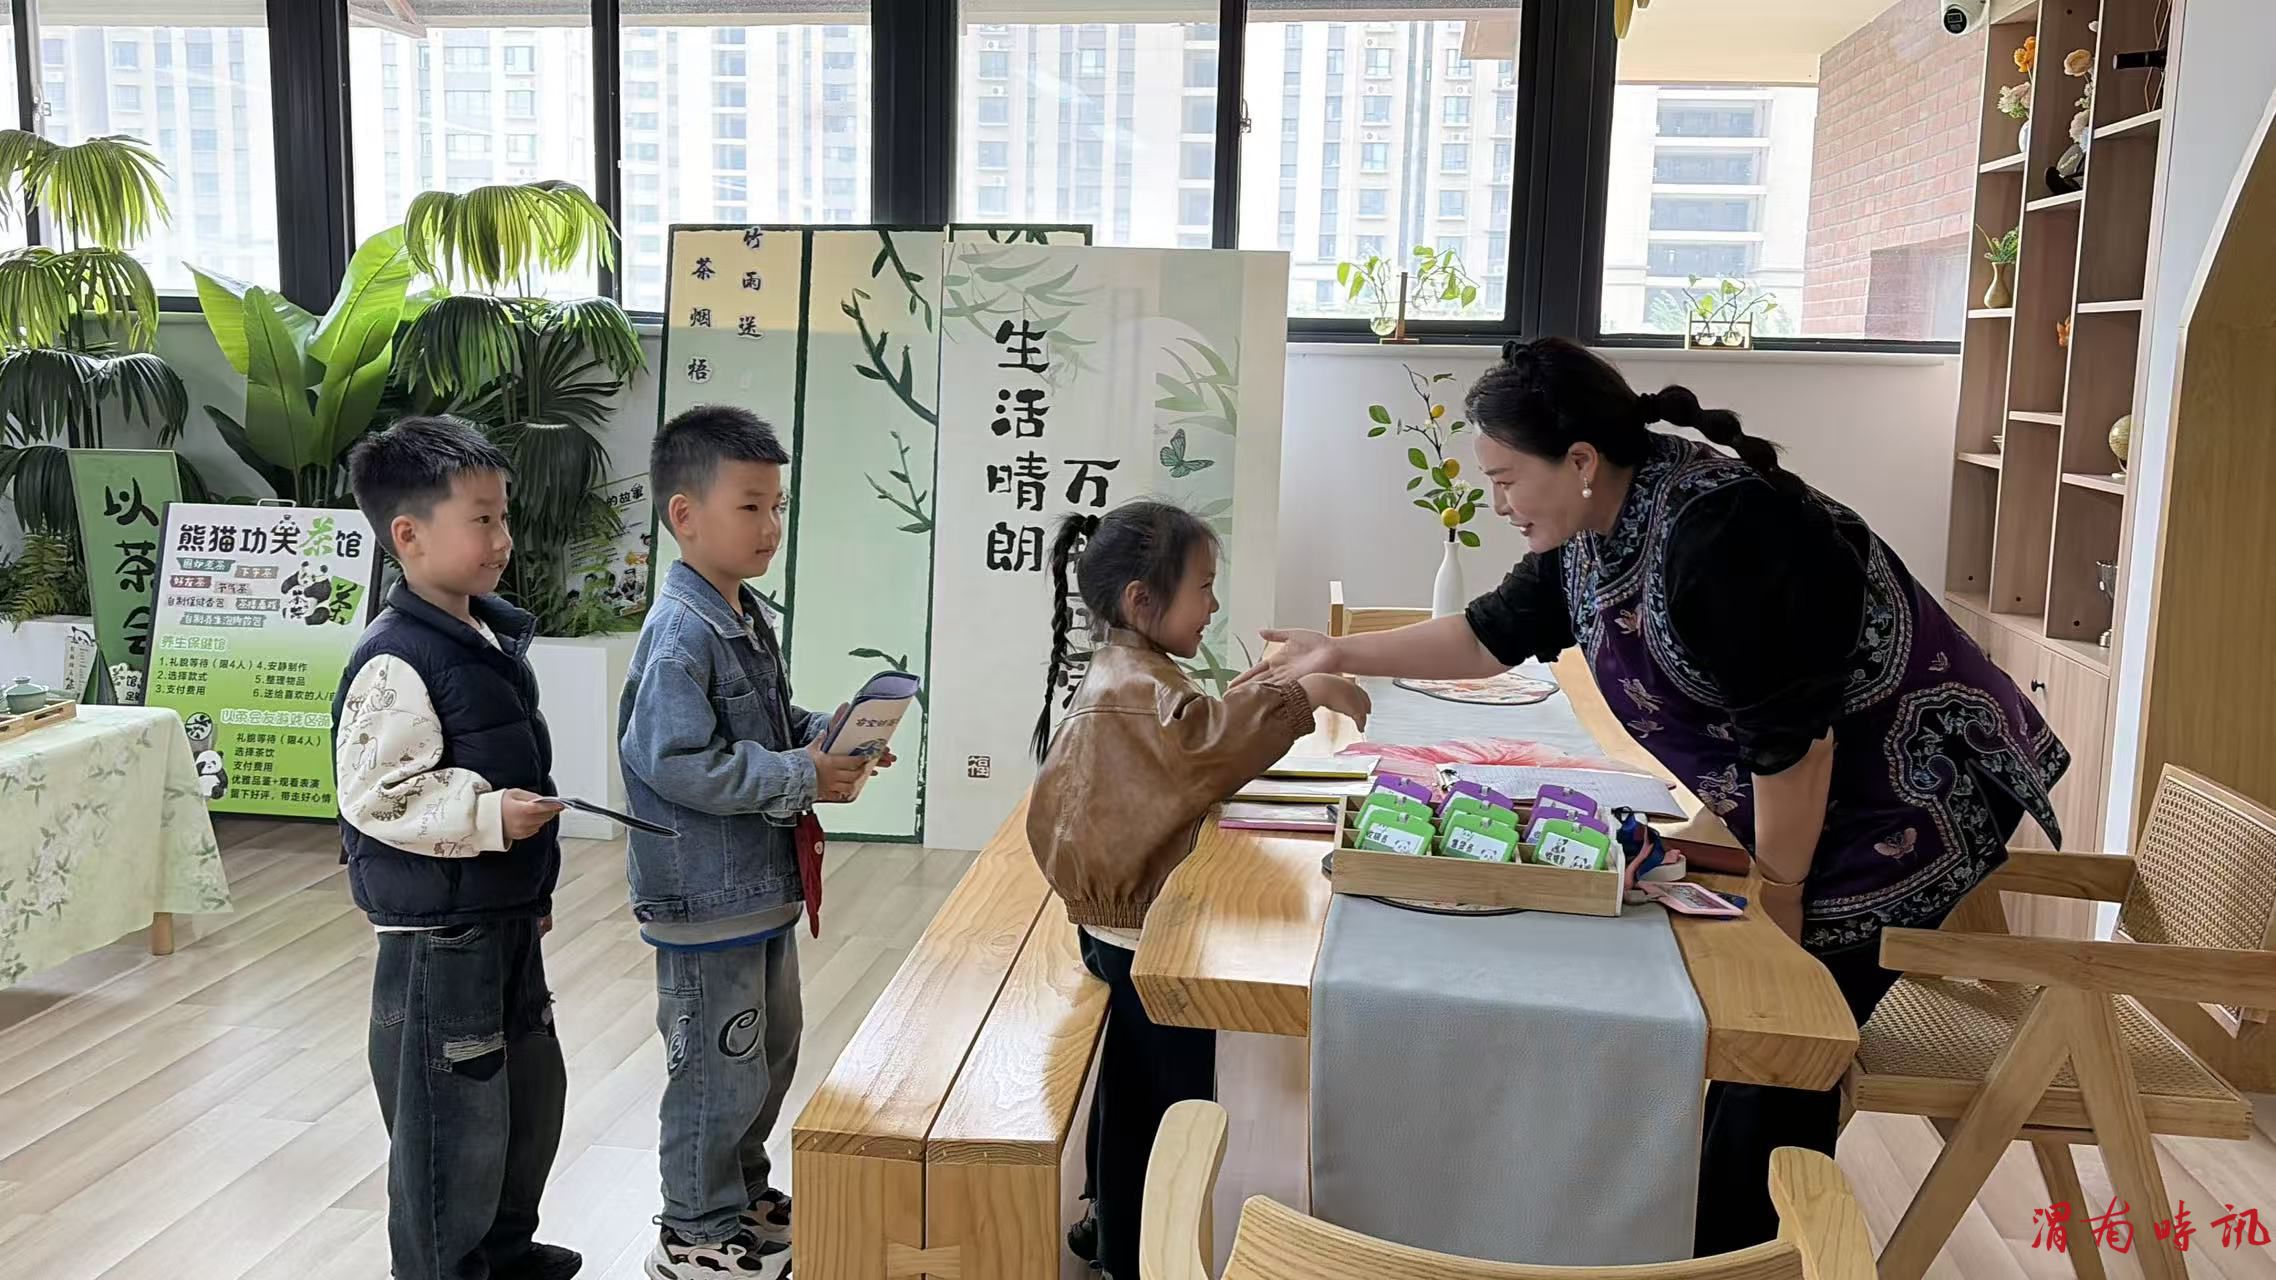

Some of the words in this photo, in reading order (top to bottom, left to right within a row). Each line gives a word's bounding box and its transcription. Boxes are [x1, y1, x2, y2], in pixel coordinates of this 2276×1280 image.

[738, 227, 763, 338] 竹雨送
[687, 257, 715, 409] 茶烟梧
[986, 319, 1050, 573] 生活晴朗
[159, 635, 227, 651] 养生保健馆
[155, 684, 206, 696] 3.支付费用
[233, 760, 273, 772] 支付费用
